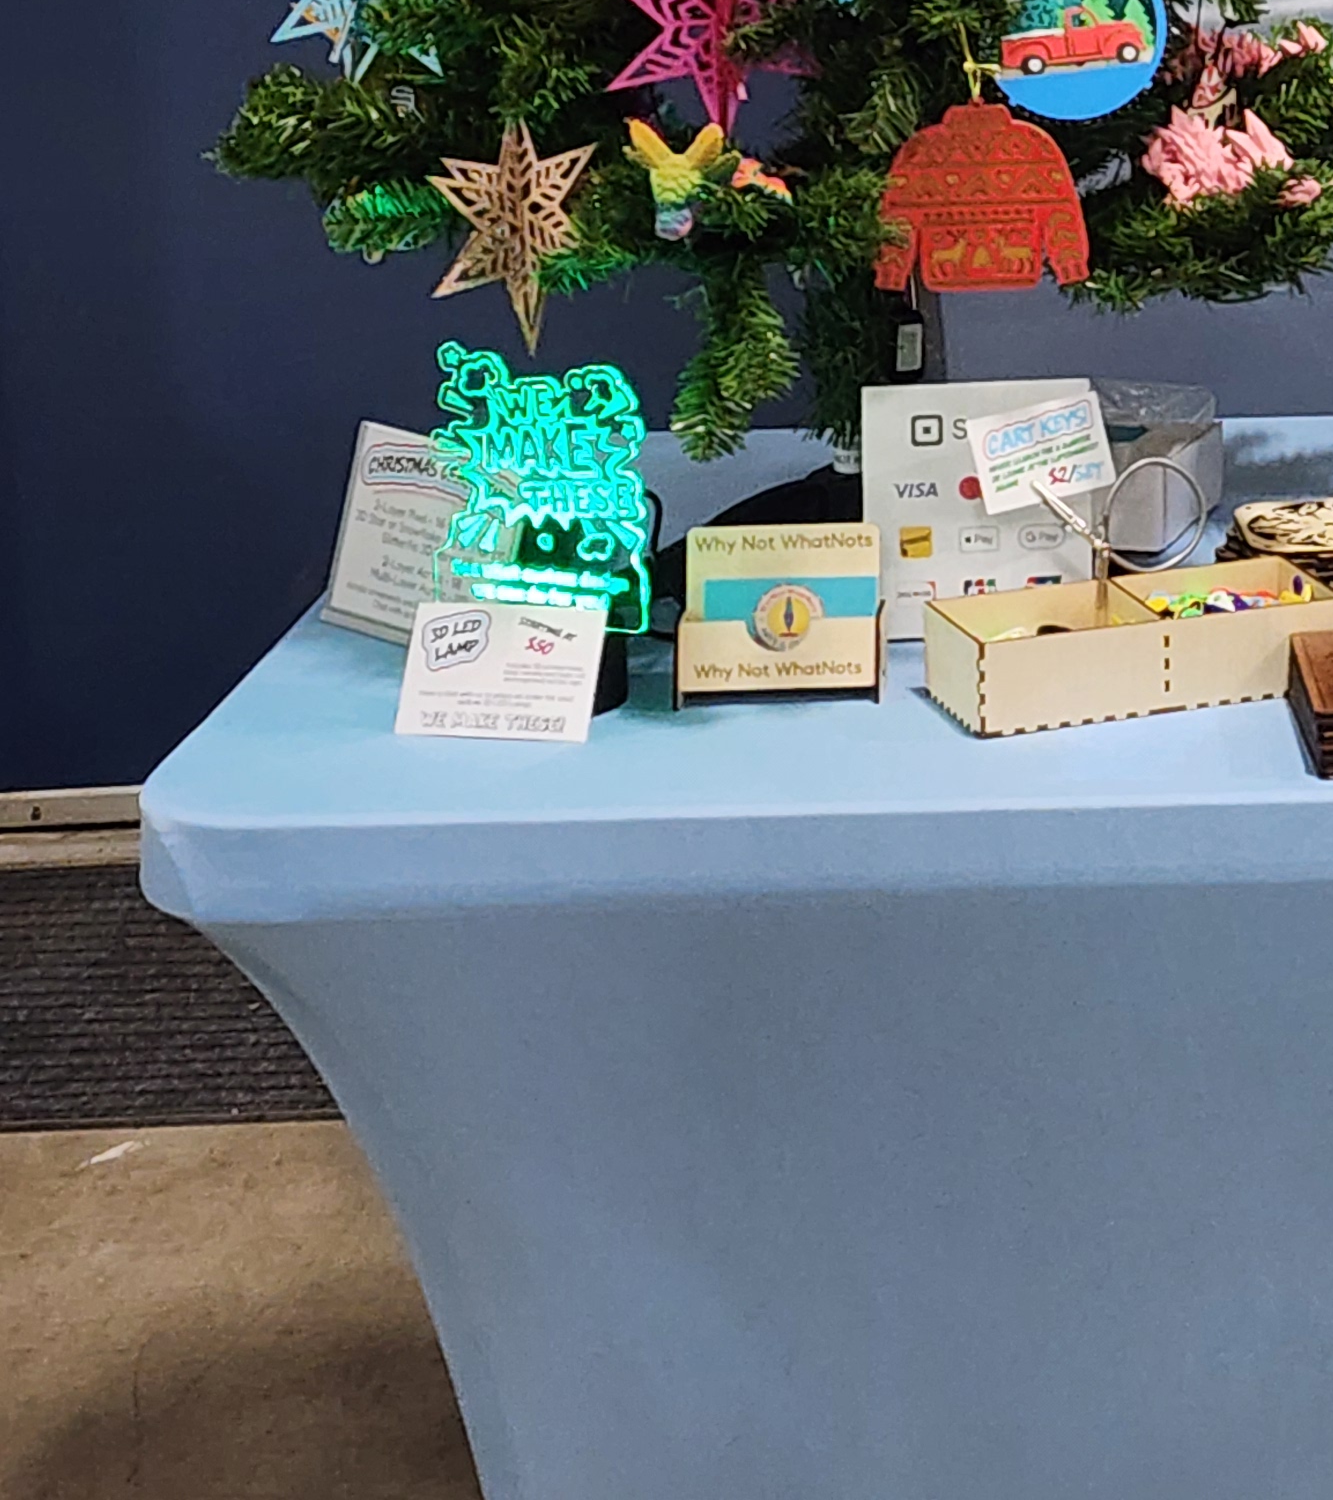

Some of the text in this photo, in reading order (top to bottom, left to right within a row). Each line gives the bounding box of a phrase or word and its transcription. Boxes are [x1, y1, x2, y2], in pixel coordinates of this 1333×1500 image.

[504, 385, 553, 424] WE
[483, 421, 601, 479] MAKE
[987, 422, 1036, 455] CART
[368, 454, 438, 478] CHRISTMAS
[520, 480, 637, 519] THESE
[893, 482, 939, 498] VISA
[694, 531, 874, 555] Why Not WhatNots
[452, 618, 483, 637] LED
[434, 638, 480, 662] LAMP
[693, 659, 863, 683] Why Not WhatNots
[420, 710, 567, 734] WE MAKE THESE!
